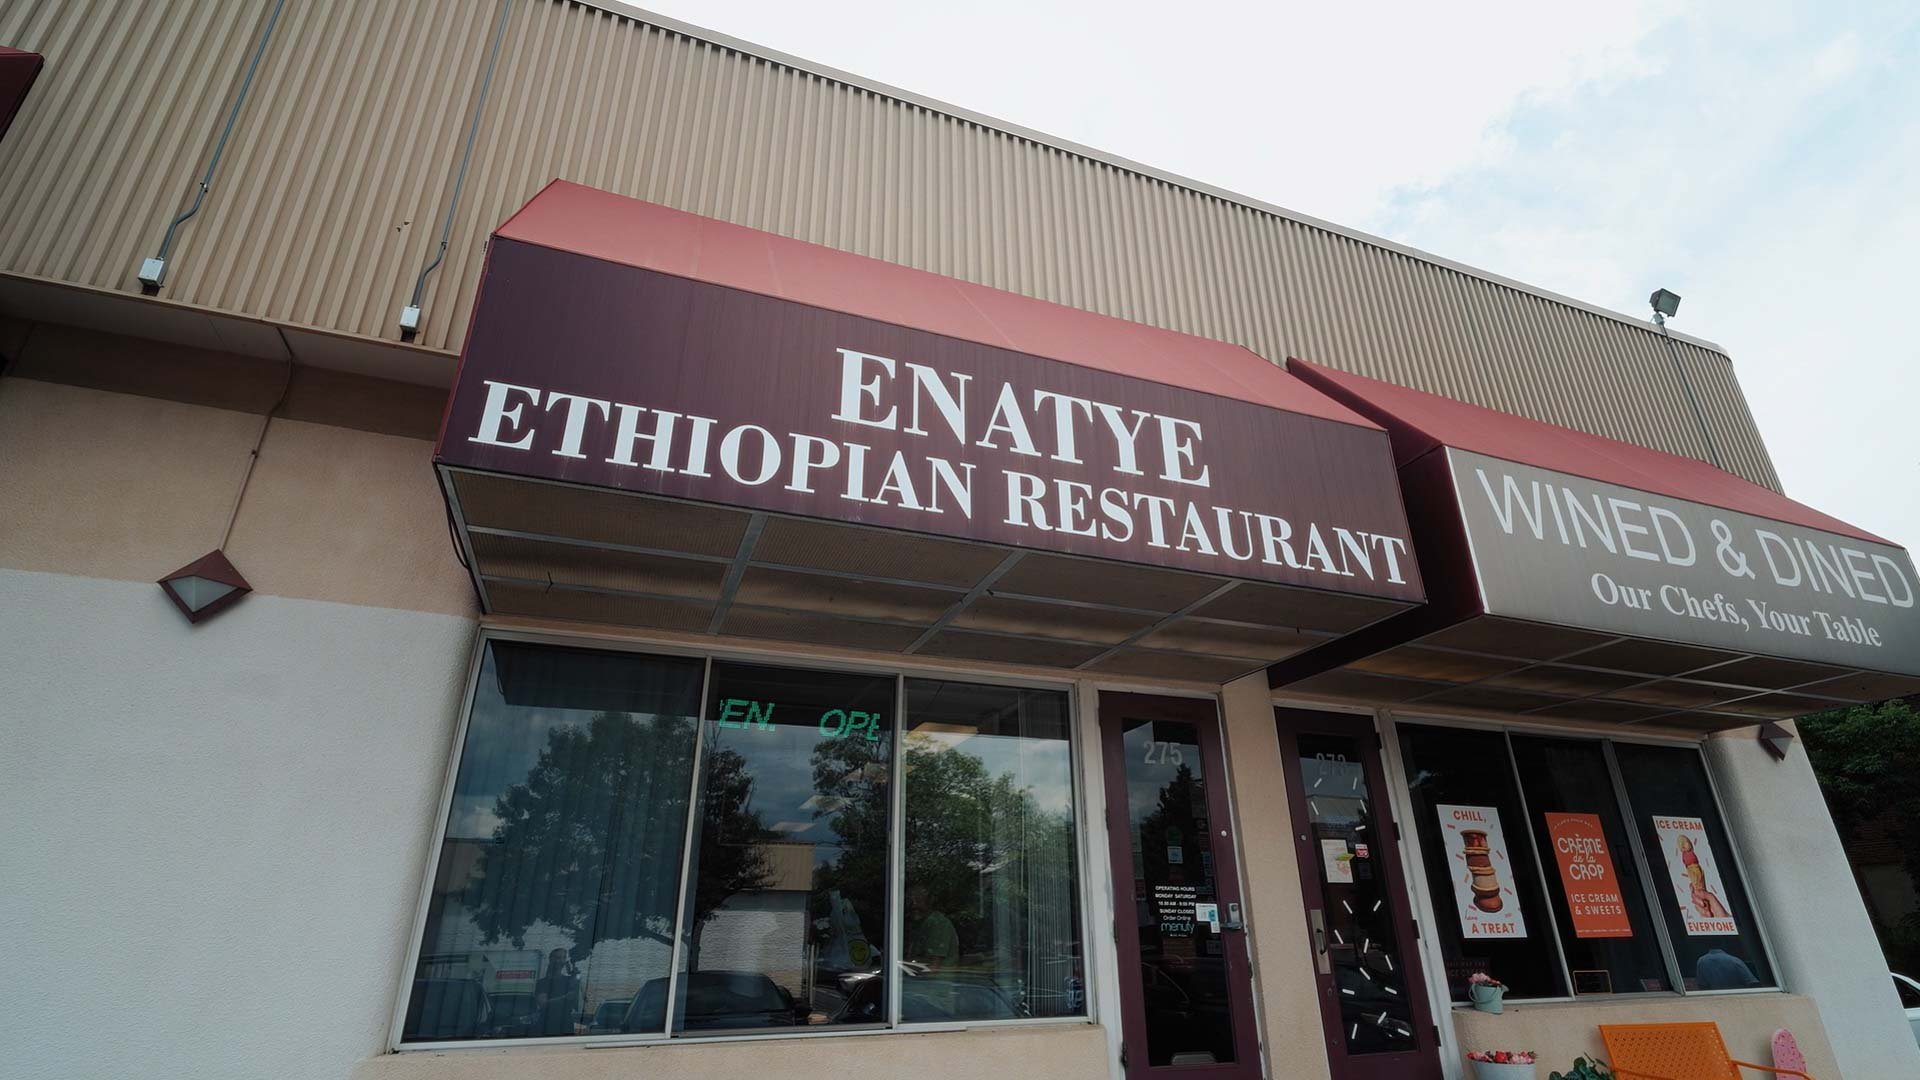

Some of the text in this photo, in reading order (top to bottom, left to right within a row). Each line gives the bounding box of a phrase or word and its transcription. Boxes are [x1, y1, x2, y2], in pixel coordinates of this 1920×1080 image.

[831, 347, 1210, 487] ENATYE
[467, 380, 1407, 585] ETHIOPIAN RESTAURANT
[1476, 468, 1915, 609] WINED & DINED
[1591, 573, 1883, 648] Our Chefs, Your Table
[720, 698, 776, 732] EN.
[1143, 740, 1183, 766] 275
[1453, 810, 1487, 823] CHILL,
[1656, 820, 1703, 831] ICE CREAM
[1569, 863, 1605, 880] CROP
[1570, 893, 1619, 903] ICE CREAM
[1575, 905, 1622, 915] & SWEETS
[1472, 923, 1515, 934] A TREAT
[1687, 921, 1735, 932] EVERYONE
